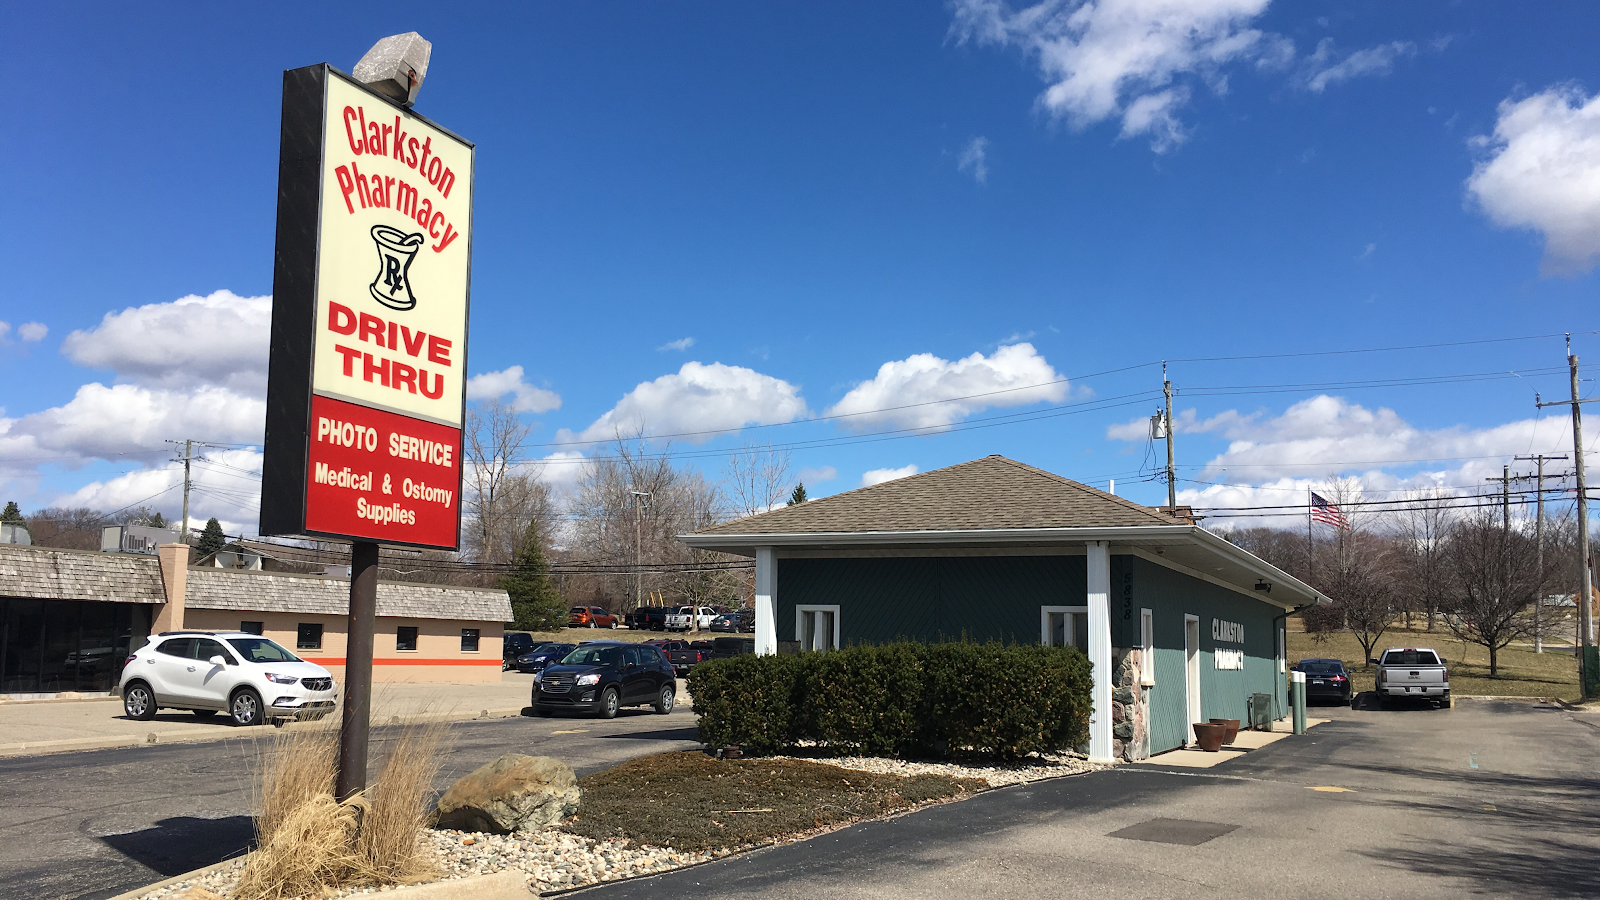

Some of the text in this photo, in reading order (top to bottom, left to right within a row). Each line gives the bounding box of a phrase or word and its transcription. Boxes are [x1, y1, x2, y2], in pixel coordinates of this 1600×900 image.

[343, 105, 456, 199] Clarkston
[335, 162, 459, 254] Pharmacy
[328, 301, 452, 367] DRIVE
[335, 344, 444, 400] THRU
[318, 416, 453, 468] PHOTO SERVICE
[315, 461, 453, 509] Medical & Ostomy
[356, 497, 416, 526] Supplies
[1212, 617, 1244, 644] CLARKSTON
